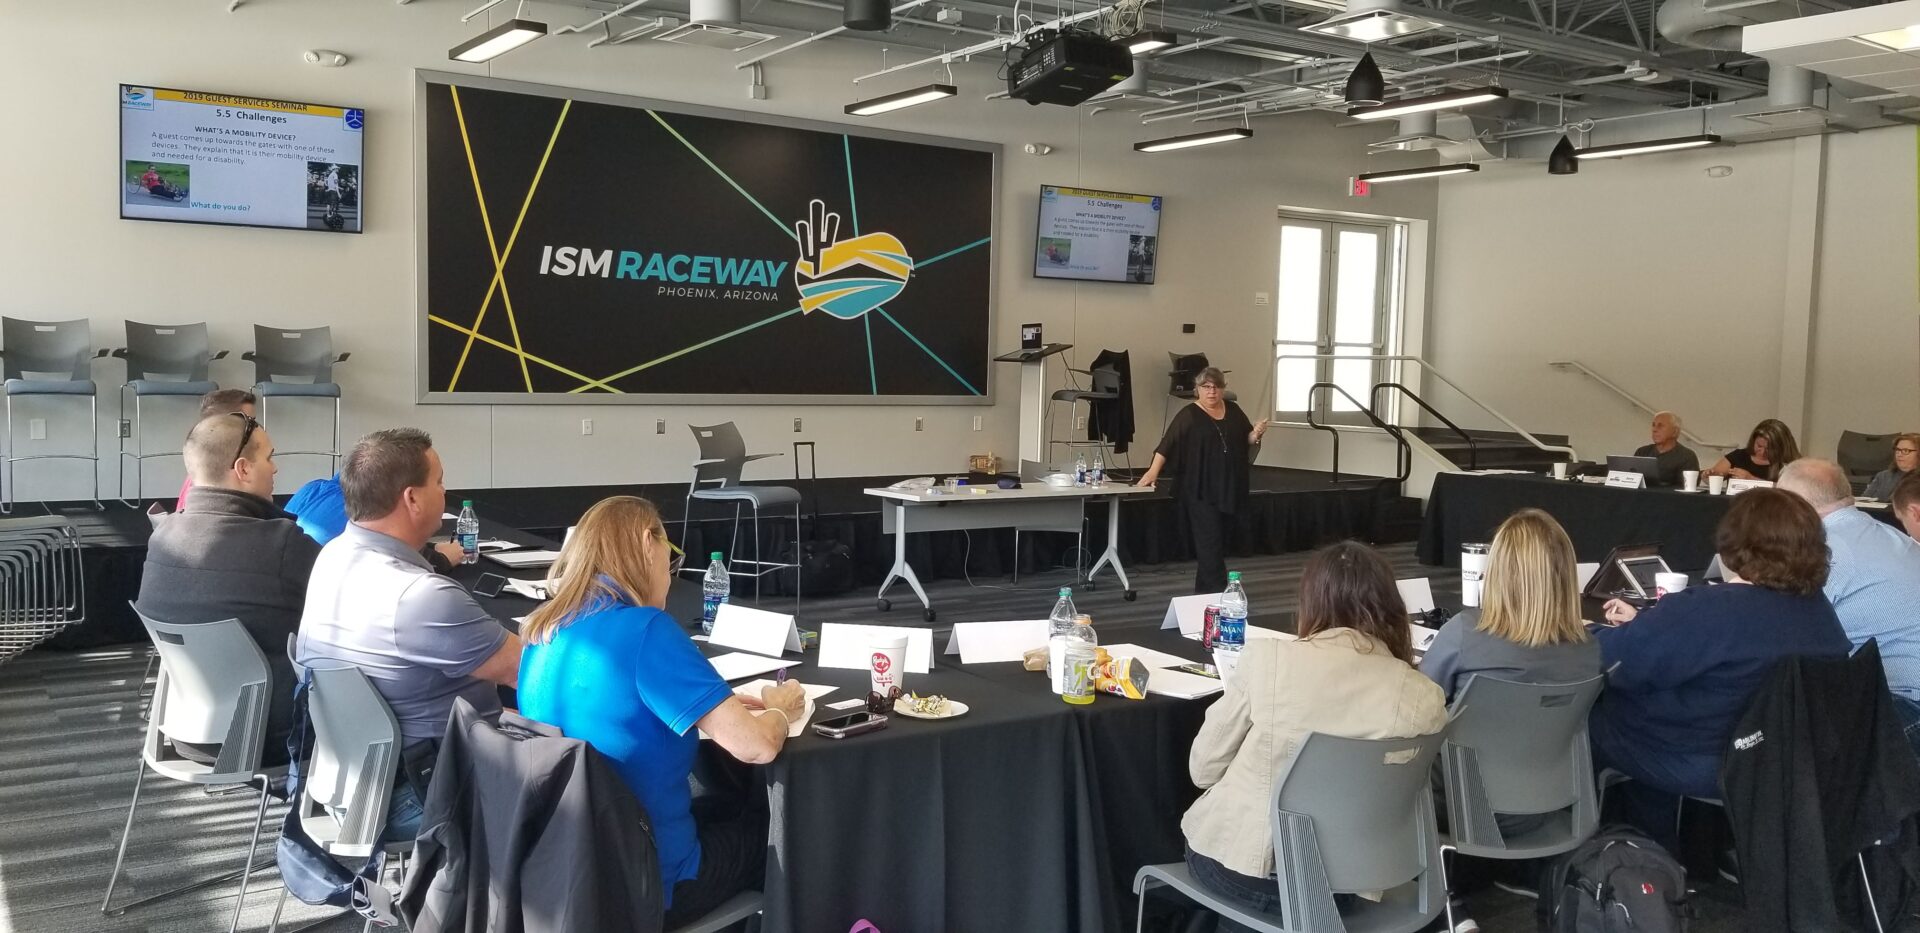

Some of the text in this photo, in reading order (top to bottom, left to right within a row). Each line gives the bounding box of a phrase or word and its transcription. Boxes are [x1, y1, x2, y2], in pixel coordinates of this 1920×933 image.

[184, 92, 308, 111] 2019 GUEST SERVICES SEMINAR
[216, 109, 287, 124] 5.5 Challenges
[194, 126, 223, 135] WHAT'S
[232, 129, 266, 139] MOBILITY
[268, 133, 296, 141] DEVICE?
[184, 144, 201, 152] They
[203, 145, 228, 154] explain
[276, 152, 304, 161] mobility
[215, 137, 244, 146] towards
[317, 146, 335, 154] these
[190, 201, 211, 209] What
[1097, 201, 1123, 209] Challenges
[540, 245, 788, 287] ISM RACEWAY
[657, 286, 779, 301] PHOENIX, ARIZONA
